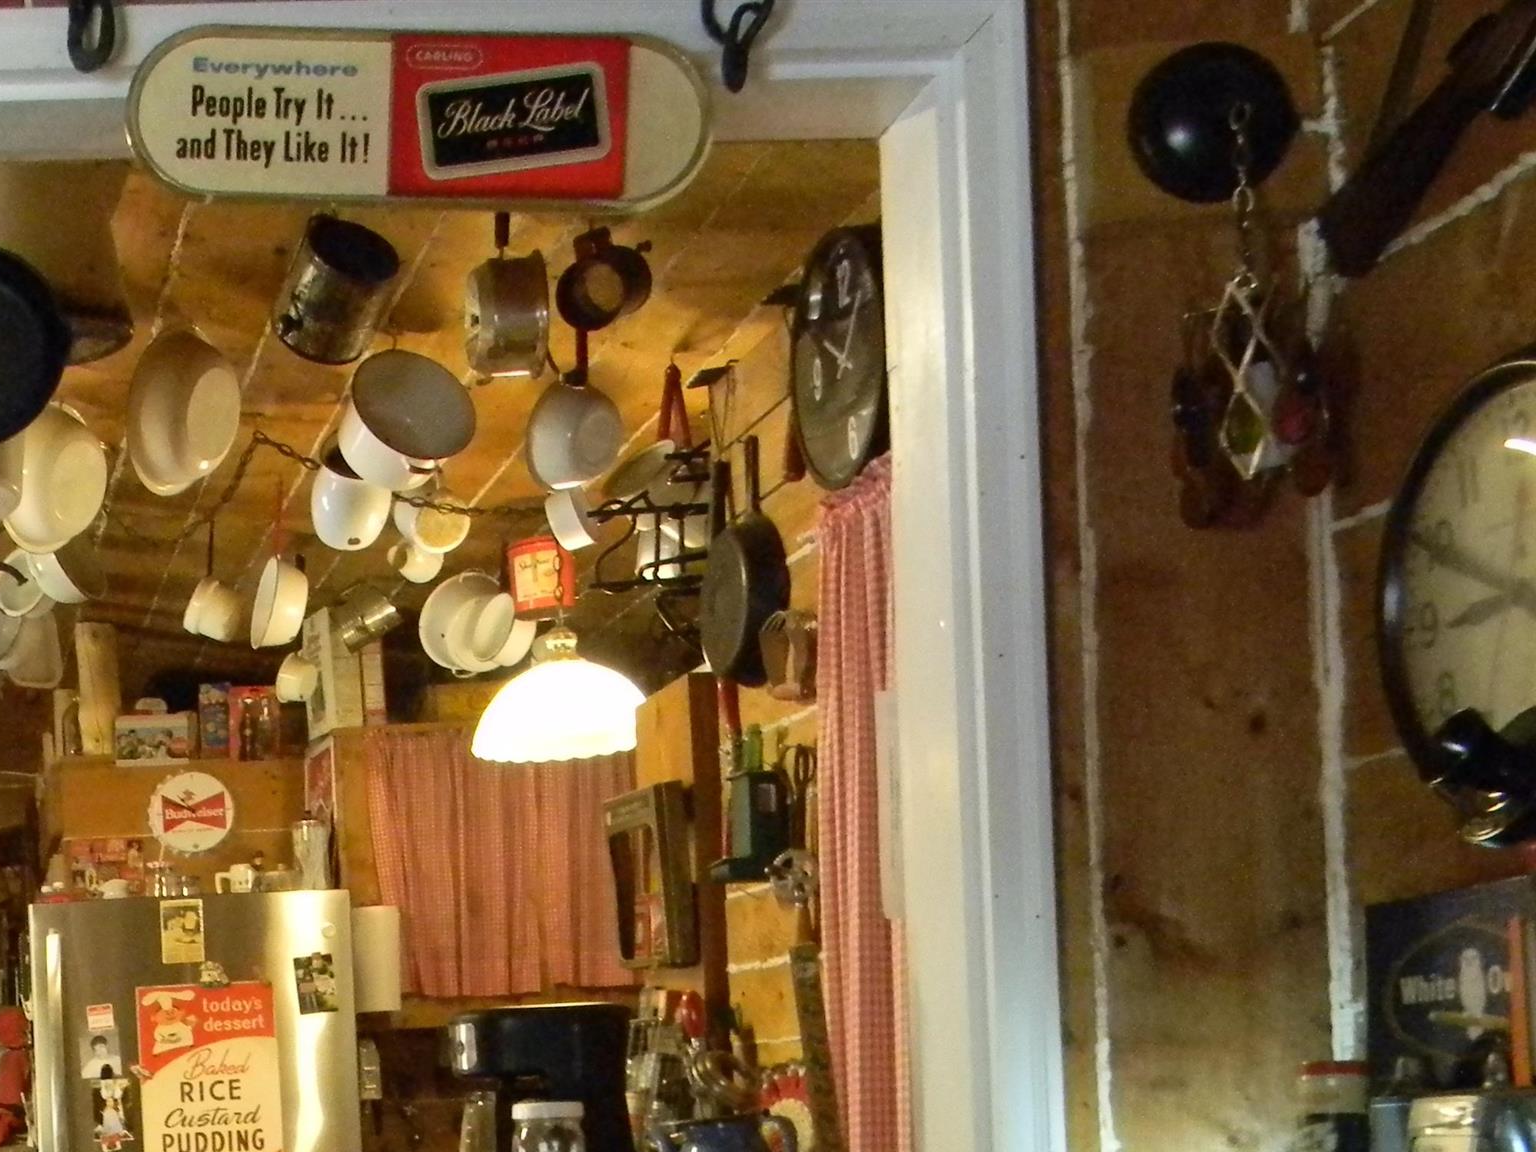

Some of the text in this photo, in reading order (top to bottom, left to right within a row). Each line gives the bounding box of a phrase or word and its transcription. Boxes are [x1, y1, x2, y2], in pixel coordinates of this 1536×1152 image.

[192, 57, 359, 80] Everywhere
[415, 51, 474, 63] CARLING
[192, 85, 266, 124] People
[274, 87, 306, 126] Try
[436, 87, 591, 139] Black Label
[176, 128, 217, 160] and
[223, 129, 276, 169] They
[284, 131, 329, 163] Like
[202, 996, 264, 1013] today's
[203, 1014, 266, 1033] dessert
[183, 1048, 250, 1080] Baked
[180, 1078, 242, 1103] RICE
[164, 1104, 261, 1129] Custard
